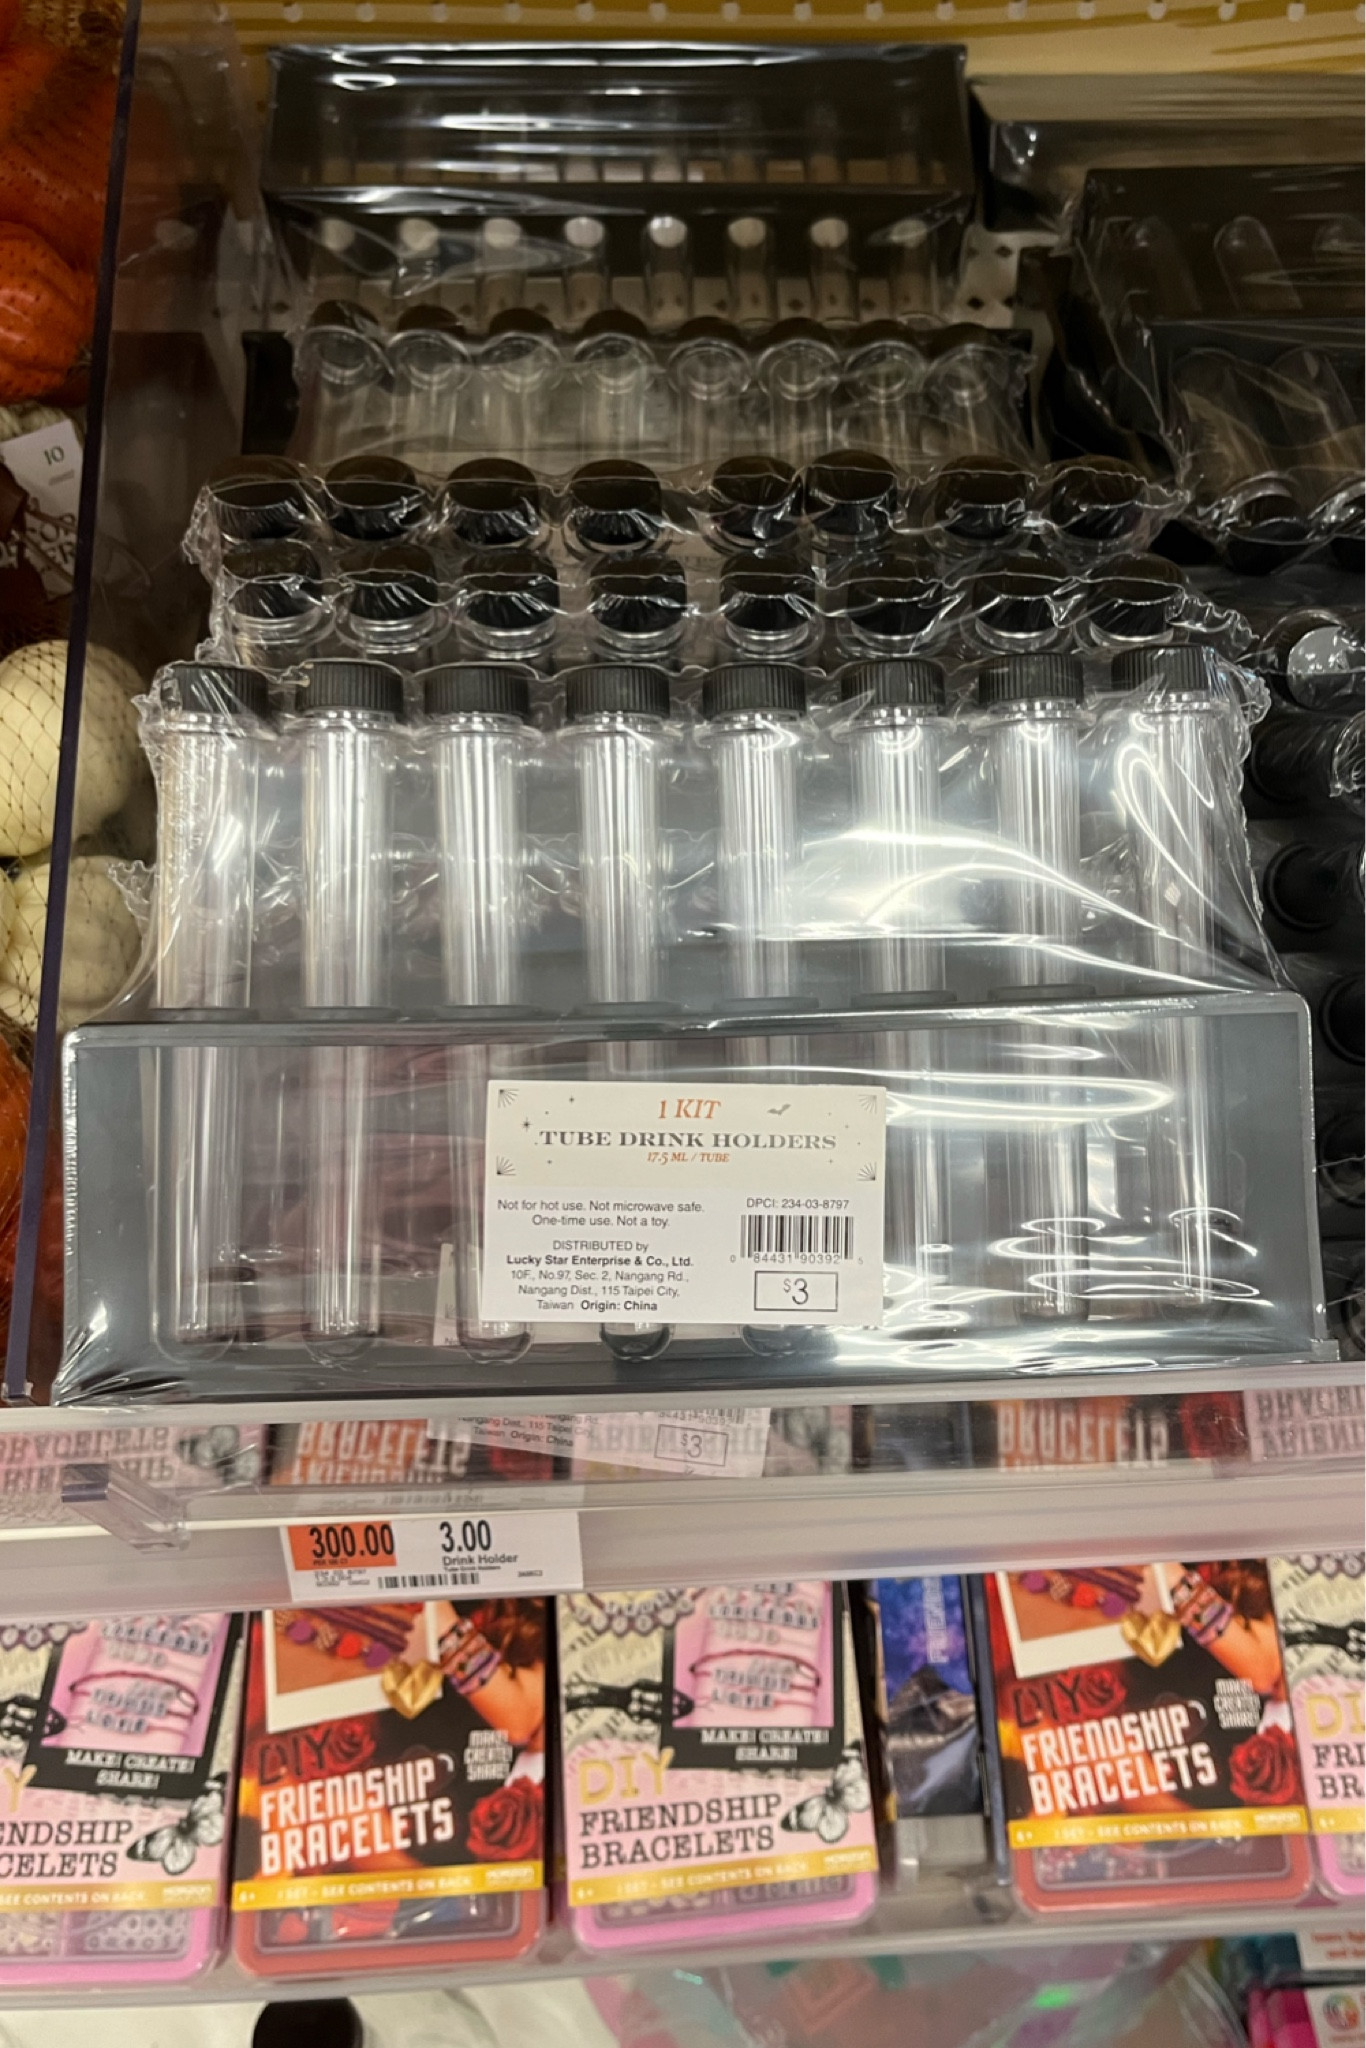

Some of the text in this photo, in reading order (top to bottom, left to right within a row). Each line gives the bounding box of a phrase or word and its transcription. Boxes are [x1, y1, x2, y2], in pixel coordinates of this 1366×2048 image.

[658, 1098, 721, 1119] 1 KIT
[539, 1130, 836, 1150] TUBE DRINK HOLDERS
[647, 1152, 669, 1165] 17.5
[671, 1152, 688, 1162] ML
[700, 1153, 729, 1163] TUBE
[498, 1200, 704, 1212] Not for hot use. Not microwave safe.
[747, 1198, 849, 1209] DPCI: 234-03-8797
[532, 1215, 670, 1228] One-time use. Not a toy.
[553, 1240, 649, 1253] DISTRIBUTED by
[507, 1255, 693, 1267] Lucky Star Enterprise & Co., Ltd.
[730, 1255, 736, 1263] 0
[754, 1254, 792, 1264] 84431
[800, 1254, 841, 1264] 90392
[575, 1271, 599, 1280] Sec.
[602, 1271, 612, 1282] 2,
[616, 1271, 664, 1283] Nangang
[518, 1285, 680, 1298] Nangang Dist., 115 Taipei City,
[784, 1278, 809, 1305] $3
[537, 1300, 657, 1312] Taiwan Origin: China
[546, 1436, 573, 1447] China
[681, 1433, 702, 1458] $3
[310, 1524, 395, 1558] 300.00
[440, 1520, 492, 1552] 3.00
[442, 1554, 518, 1566] Drink Holder
[1012, 1672, 1081, 1728] DIY
[701, 1729, 829, 1743] MAKE! CREATE!
[1021, 1704, 1191, 1773] FRIENDSHIP
[65, 1750, 195, 1773] MAKE! CREATE!
[259, 1726, 332, 1786] DIY
[736, 1746, 798, 1761] SHARE!
[96, 1770, 160, 1790] SHARE!
[579, 1748, 675, 1805] DIY
[1028, 1744, 1217, 1815] BRACELETS
[1317, 1774, 1365, 1798] BR
[260, 1757, 436, 1831] FRIENDSHIP
[580, 1794, 782, 1837] FRIENDSHIP
[261, 1798, 453, 1875] BRACELETS
[582, 1826, 774, 1869] BRACELETS
